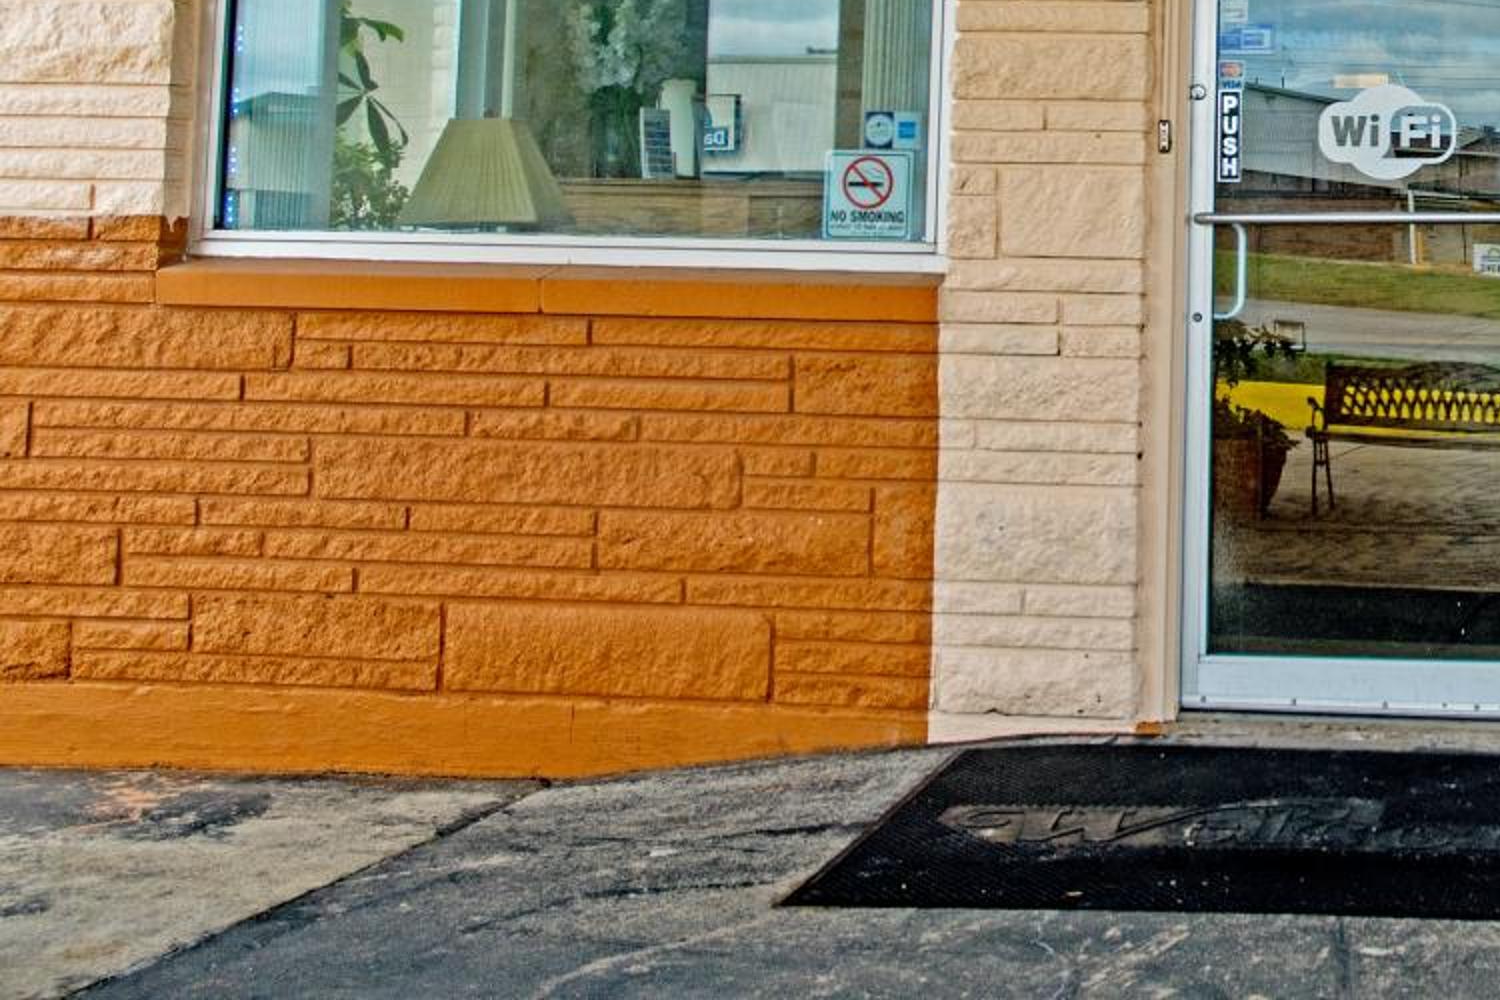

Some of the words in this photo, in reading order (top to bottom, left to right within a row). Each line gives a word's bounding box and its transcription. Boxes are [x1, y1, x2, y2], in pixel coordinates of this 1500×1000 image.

[1222, 95, 1239, 177] PUSH
[831, 210, 847, 222] NO
[850, 210, 905, 223] SMOKING
